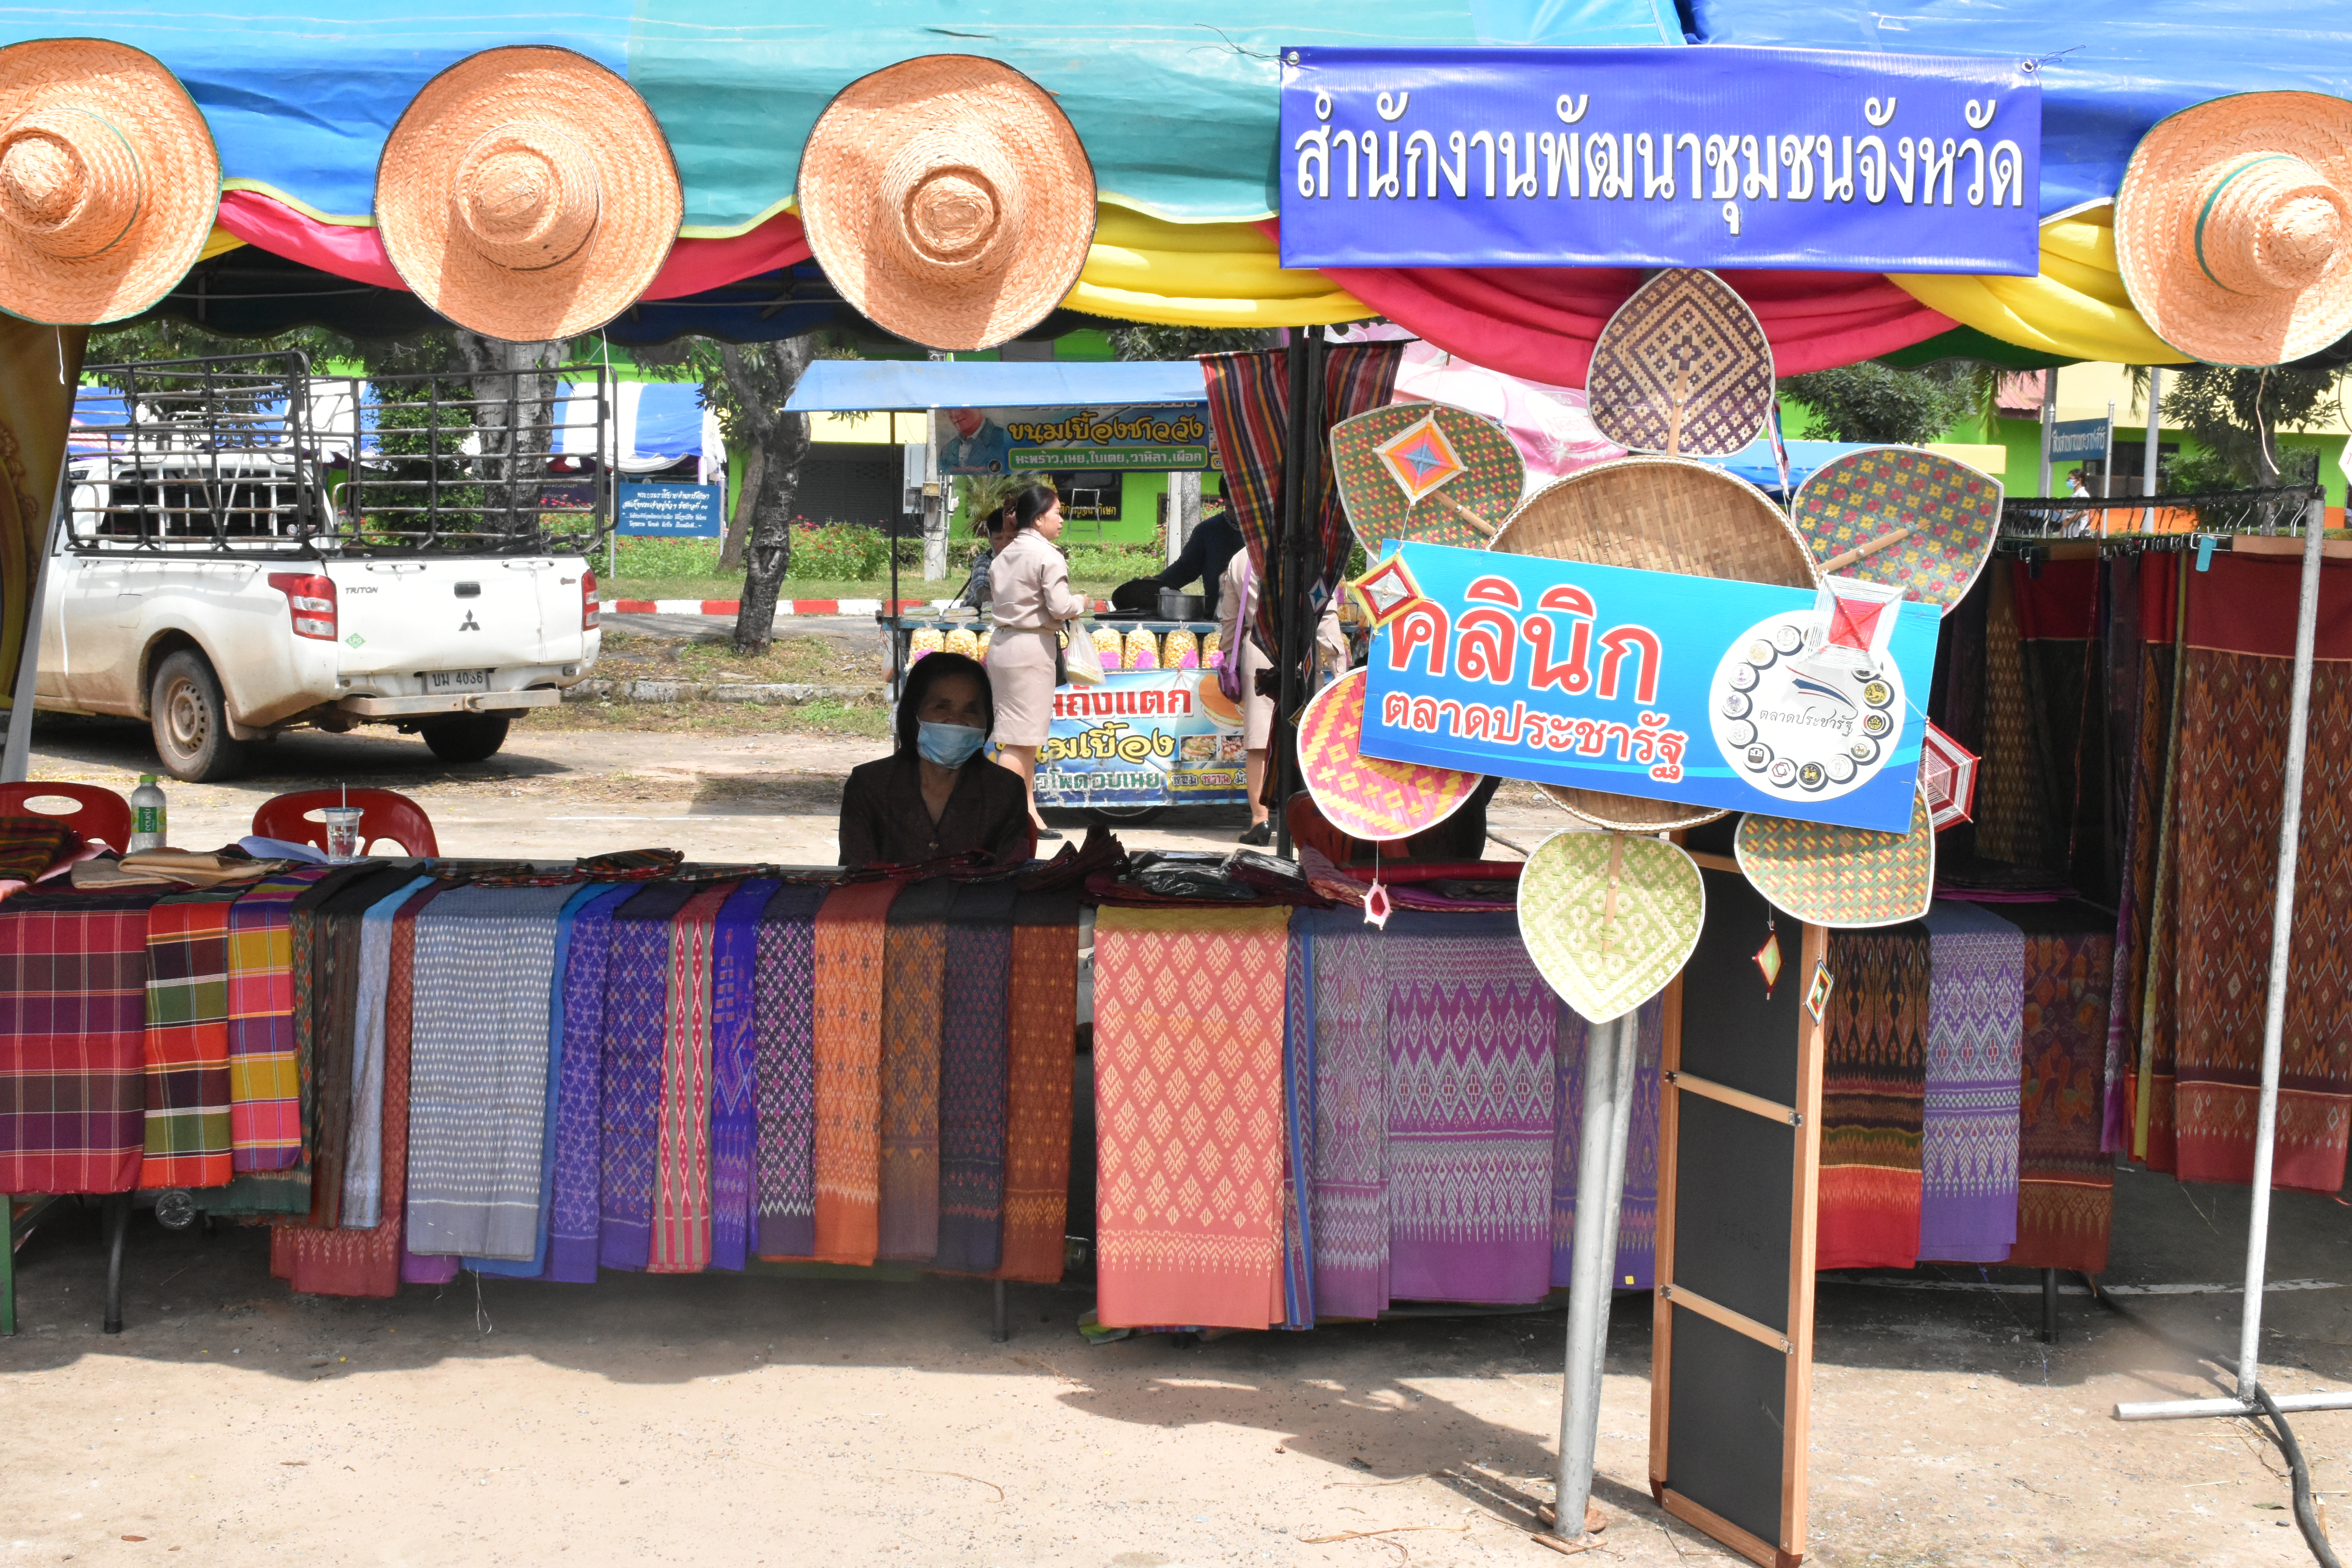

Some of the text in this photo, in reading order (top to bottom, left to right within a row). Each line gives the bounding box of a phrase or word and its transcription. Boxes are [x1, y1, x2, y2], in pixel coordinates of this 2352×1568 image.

[1295, 92, 2023, 235] สำนักงานพัฒนาชุมชนจังหวัด
[1007, 411, 1205, 445] ขนมเบื้องชาววัง
[1389, 575, 1662, 705] คลินิก
[1383, 691, 1688, 783] ตลาดประชารัฐ
[1760, 706, 1858, 737] ตลาดประชารัฐ
[1171, 773, 1198, 786] หอม
[1200, 773, 1232, 786] หวาน
